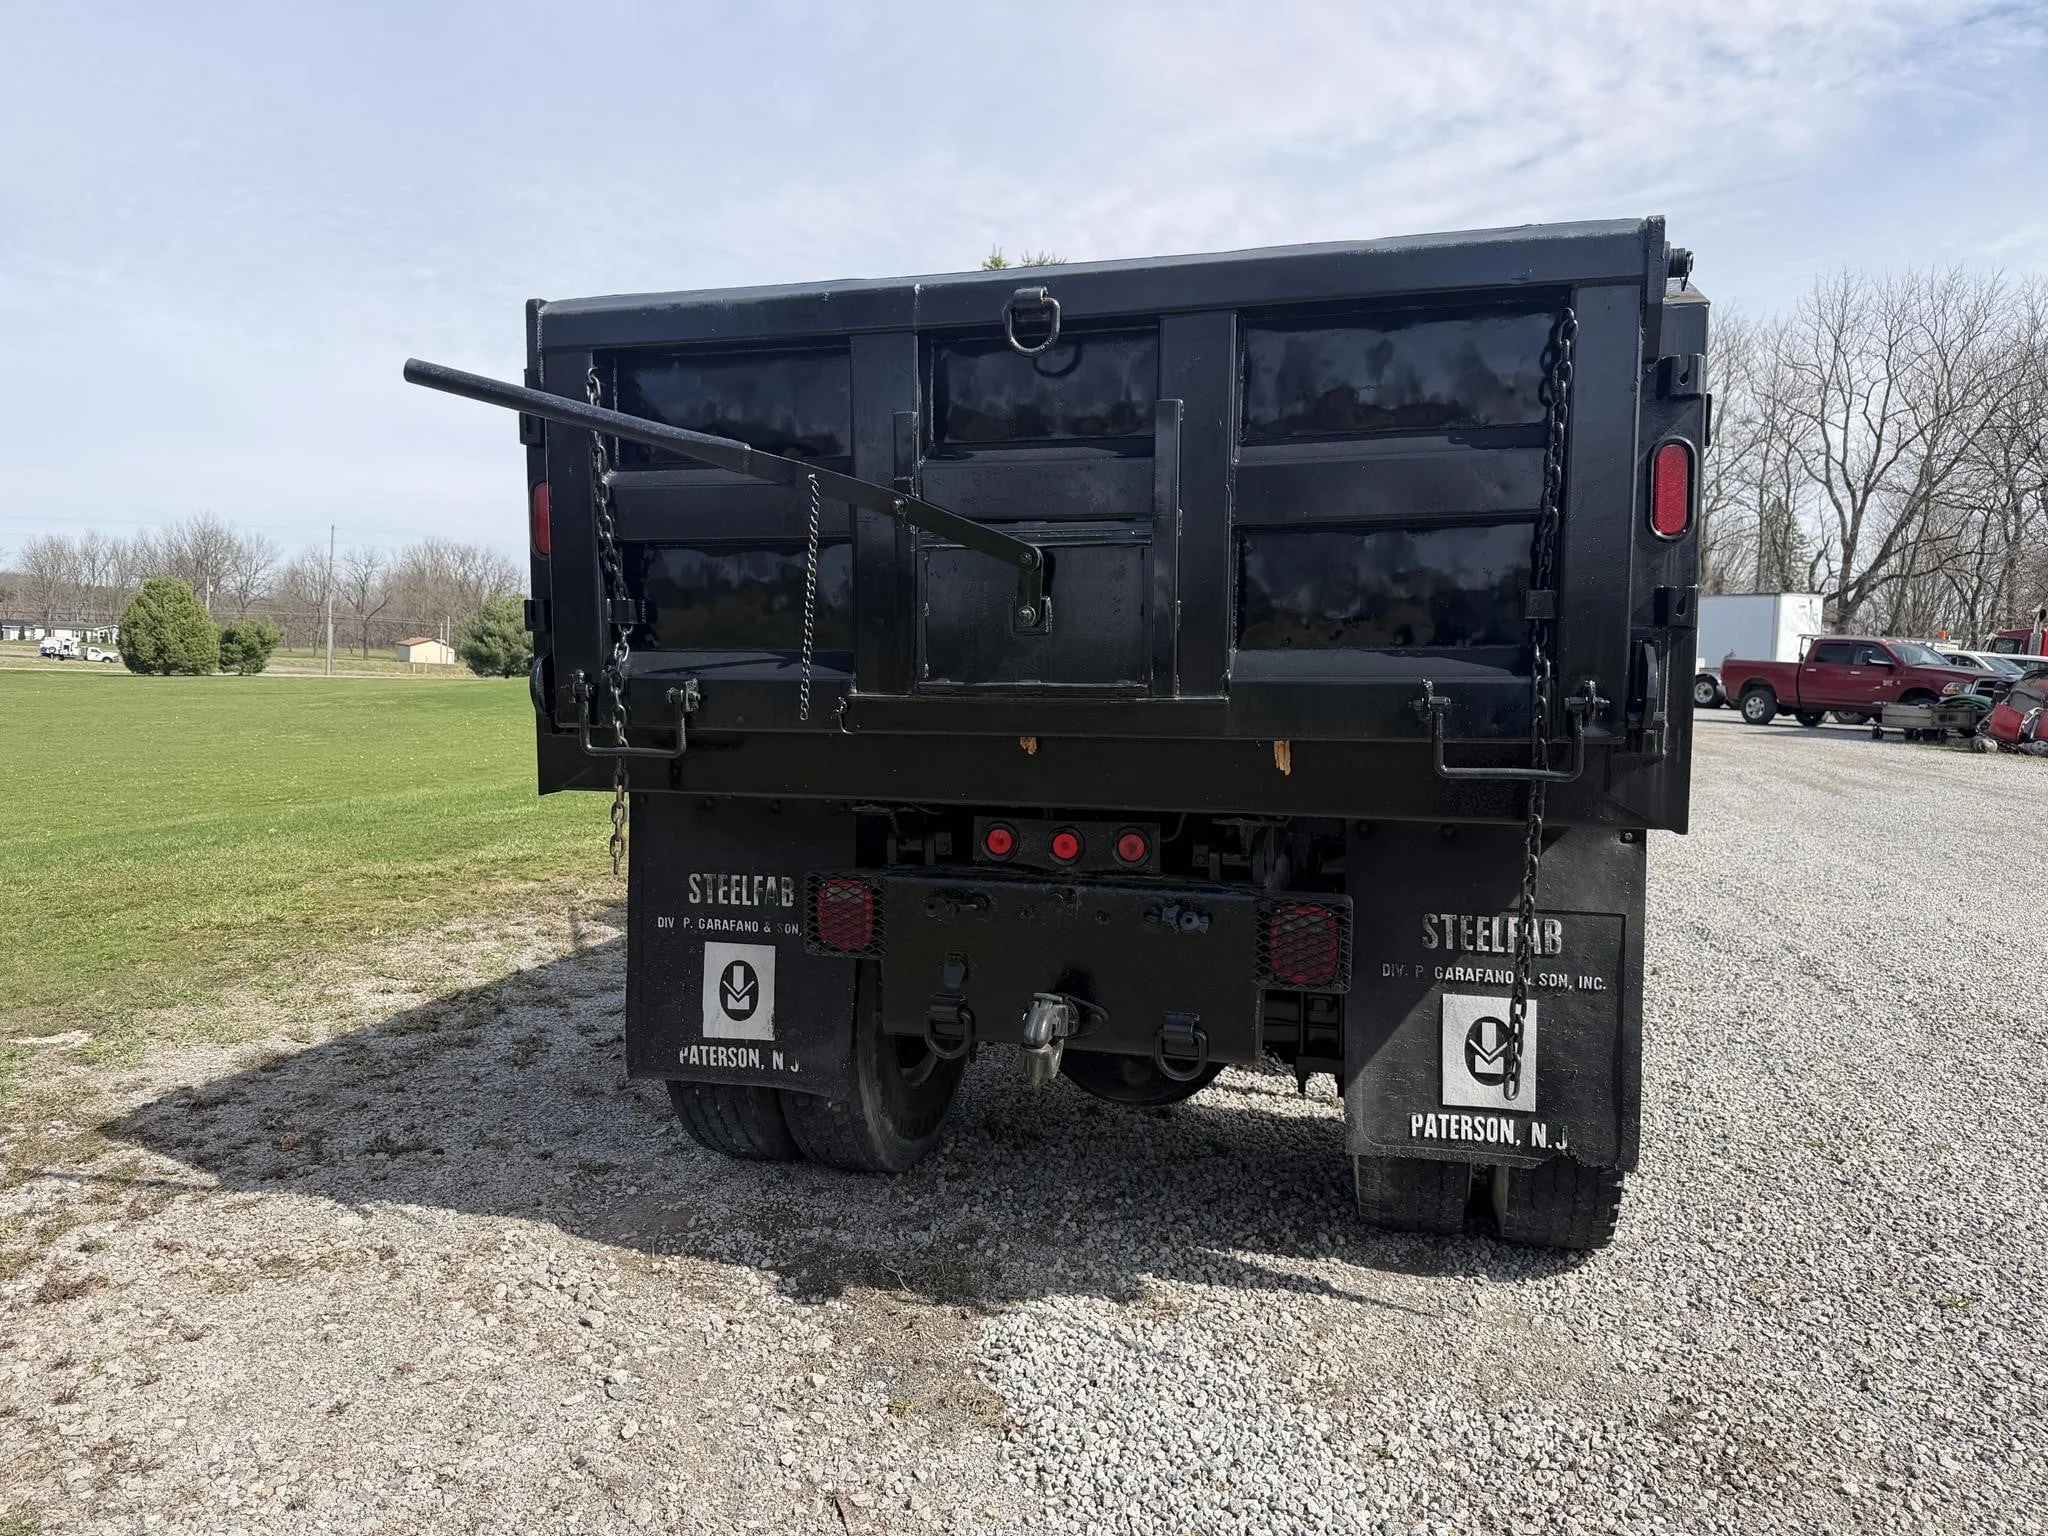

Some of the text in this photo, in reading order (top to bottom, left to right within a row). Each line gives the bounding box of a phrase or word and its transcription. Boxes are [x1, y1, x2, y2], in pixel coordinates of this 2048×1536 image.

[688, 873, 795, 907] STEELFAB
[683, 917, 693, 929] P.
[698, 918, 759, 932] GARAFANO
[763, 921, 771, 933] &
[777, 922, 802, 936] SON,
[1421, 912, 1562, 955] STEELFAB
[1434, 966, 1514, 984] GARAFANO
[1538, 973, 1572, 989] SON,
[1578, 975, 1607, 990] INC.
[679, 1045, 764, 1070] PATERSON,
[1410, 1113, 1521, 1146] PATERSON,
